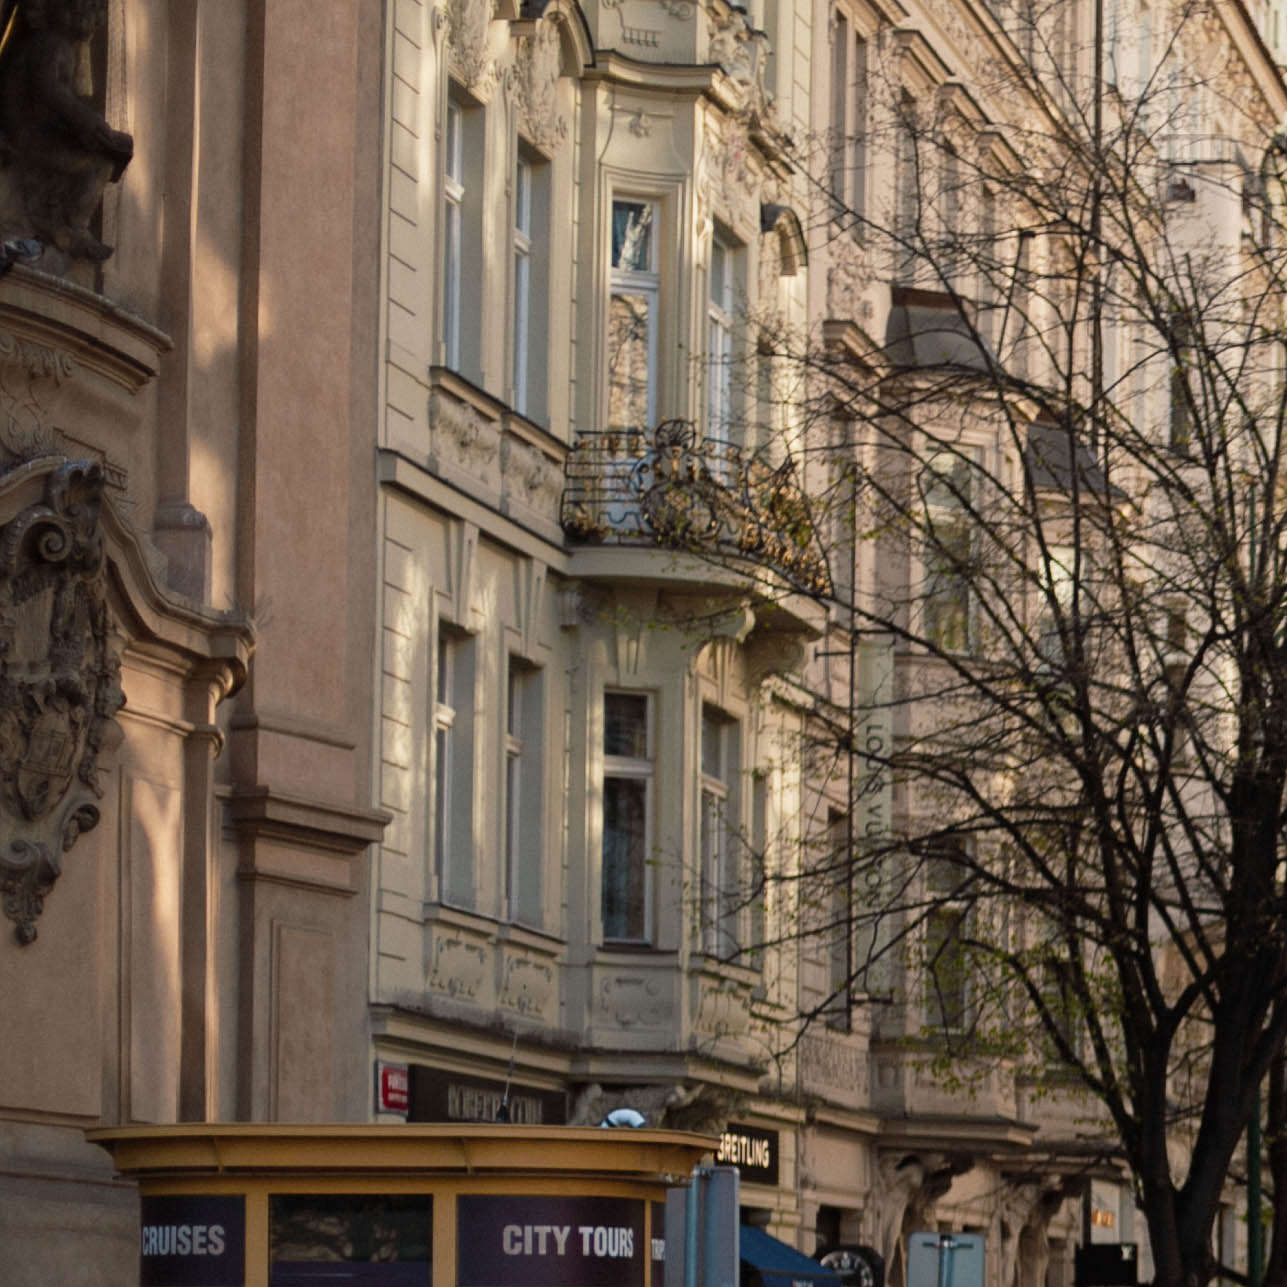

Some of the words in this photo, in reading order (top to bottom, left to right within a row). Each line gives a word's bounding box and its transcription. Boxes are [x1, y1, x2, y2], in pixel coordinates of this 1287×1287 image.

[142, 1224, 226, 1256] CRUISES
[502, 1224, 571, 1256] CITY
[578, 1226, 634, 1258] TOURS
